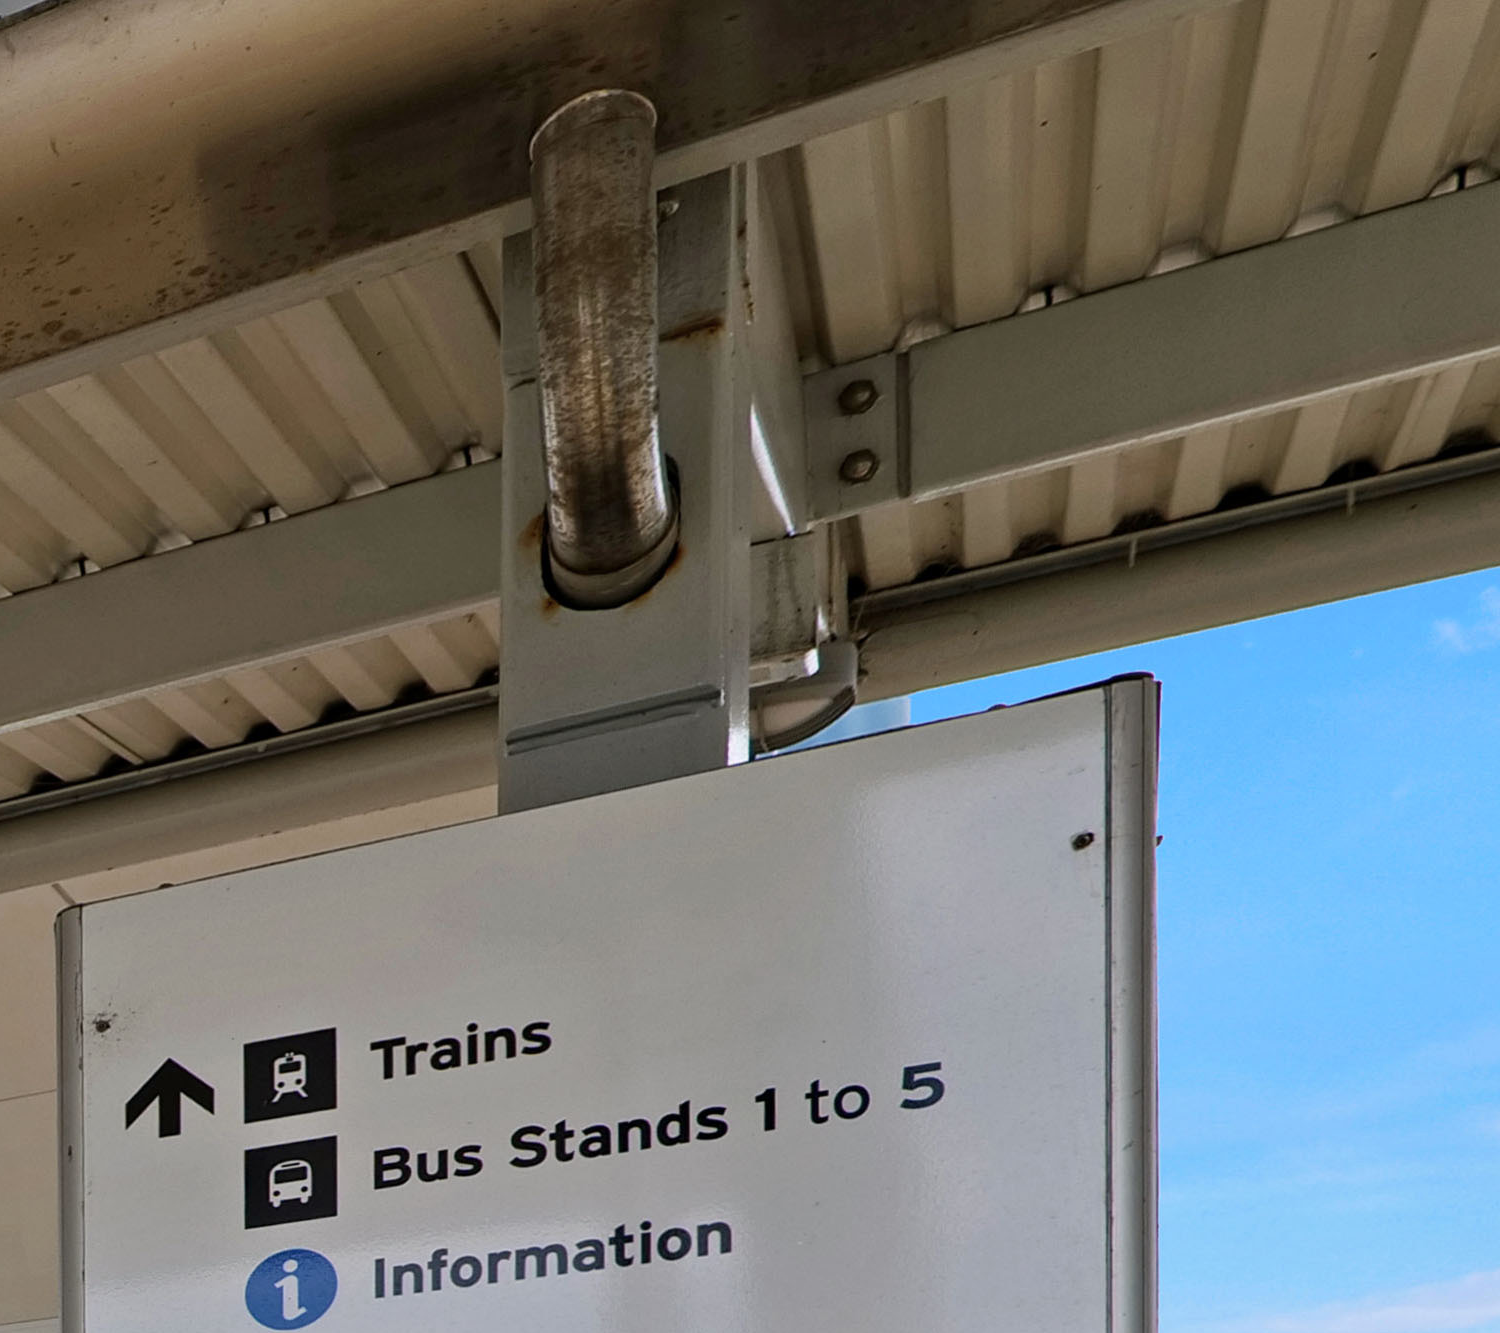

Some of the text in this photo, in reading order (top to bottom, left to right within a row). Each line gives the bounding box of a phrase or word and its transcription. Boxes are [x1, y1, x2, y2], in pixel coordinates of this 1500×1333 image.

[370, 1022, 551, 1080] Trains
[374, 1062, 944, 1190] Bus Stands 1 to 5
[375, 1220, 732, 1298] Information
